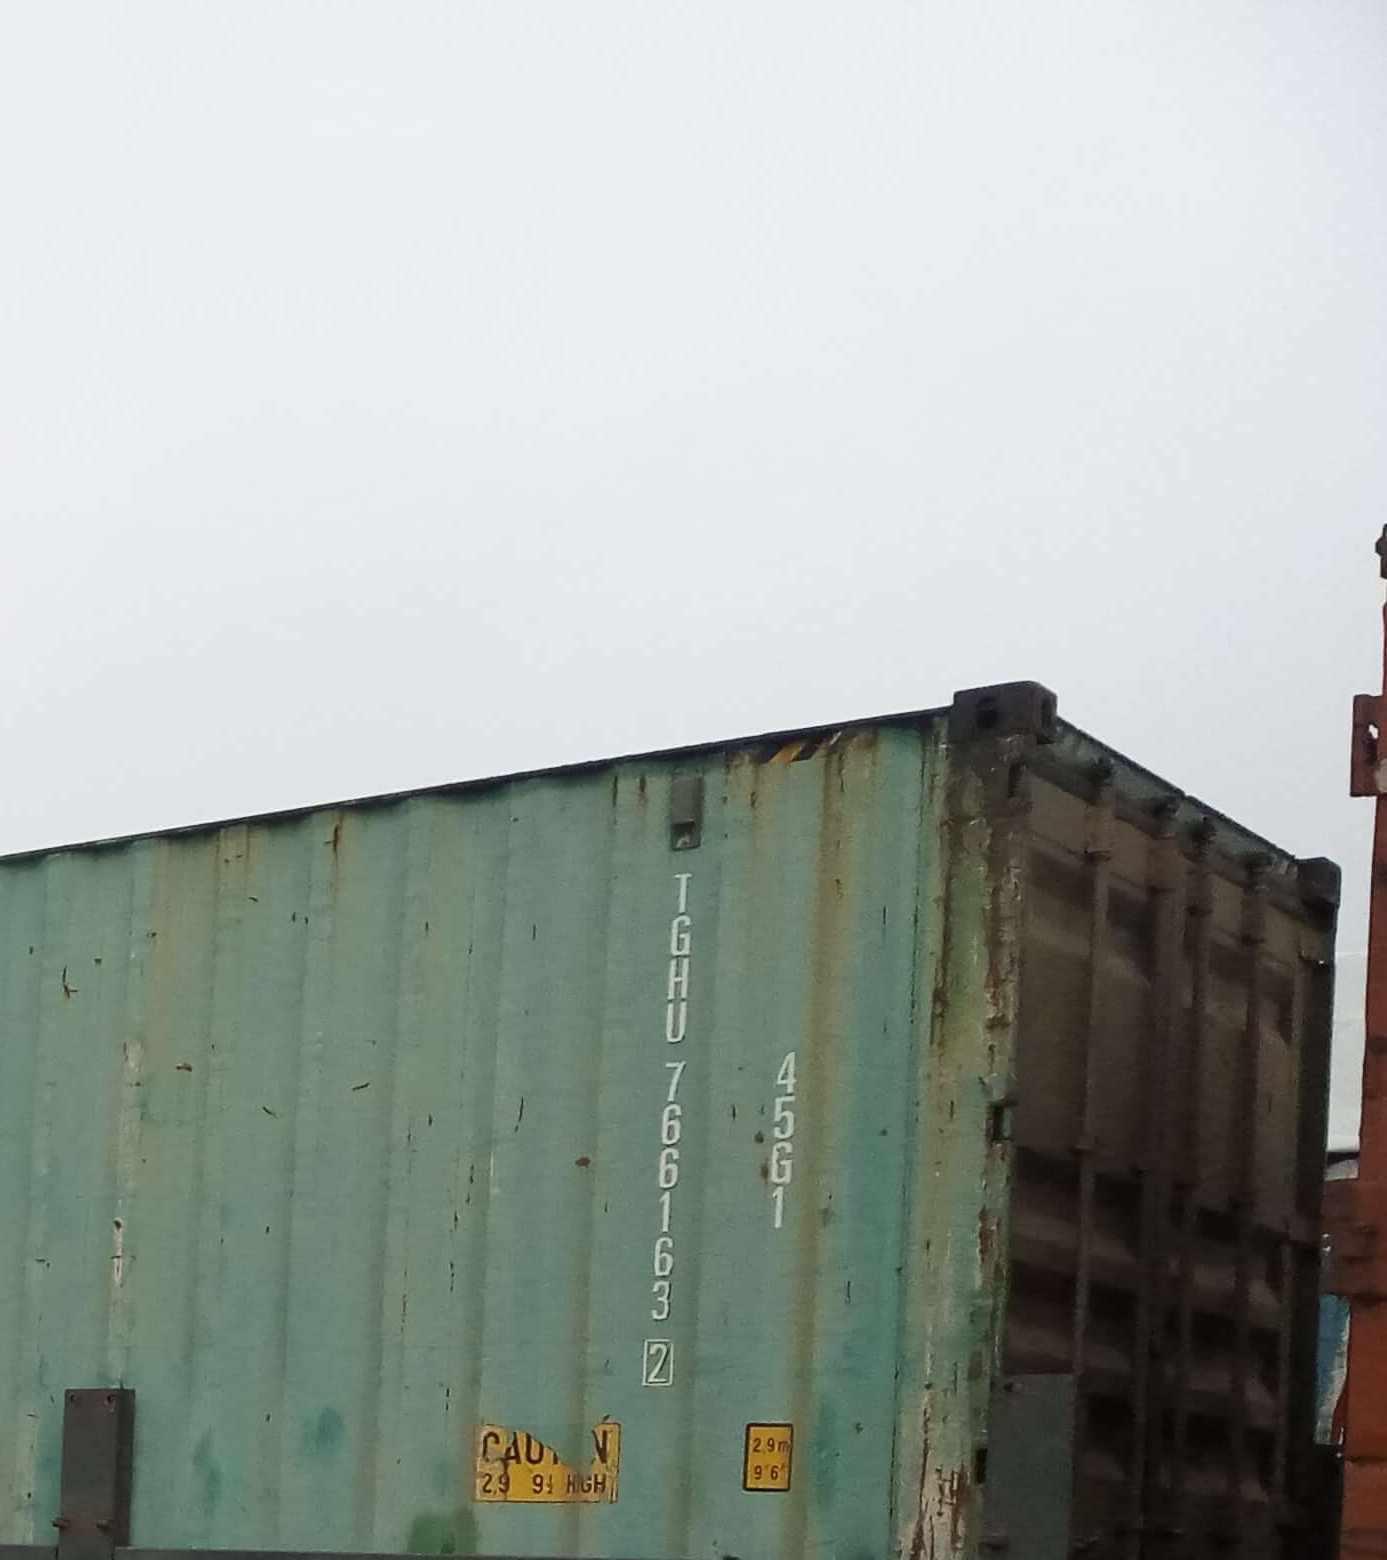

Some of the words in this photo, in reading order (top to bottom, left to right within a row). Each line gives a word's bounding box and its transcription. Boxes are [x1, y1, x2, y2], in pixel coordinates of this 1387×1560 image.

[665, 873, 692, 1043] TGHU
[651, 1060, 686, 1321] 766163
[770, 1051, 797, 1229] 45G1
[646, 1341, 670, 1383] 2
[483, 1430, 608, 1465] CAUN
